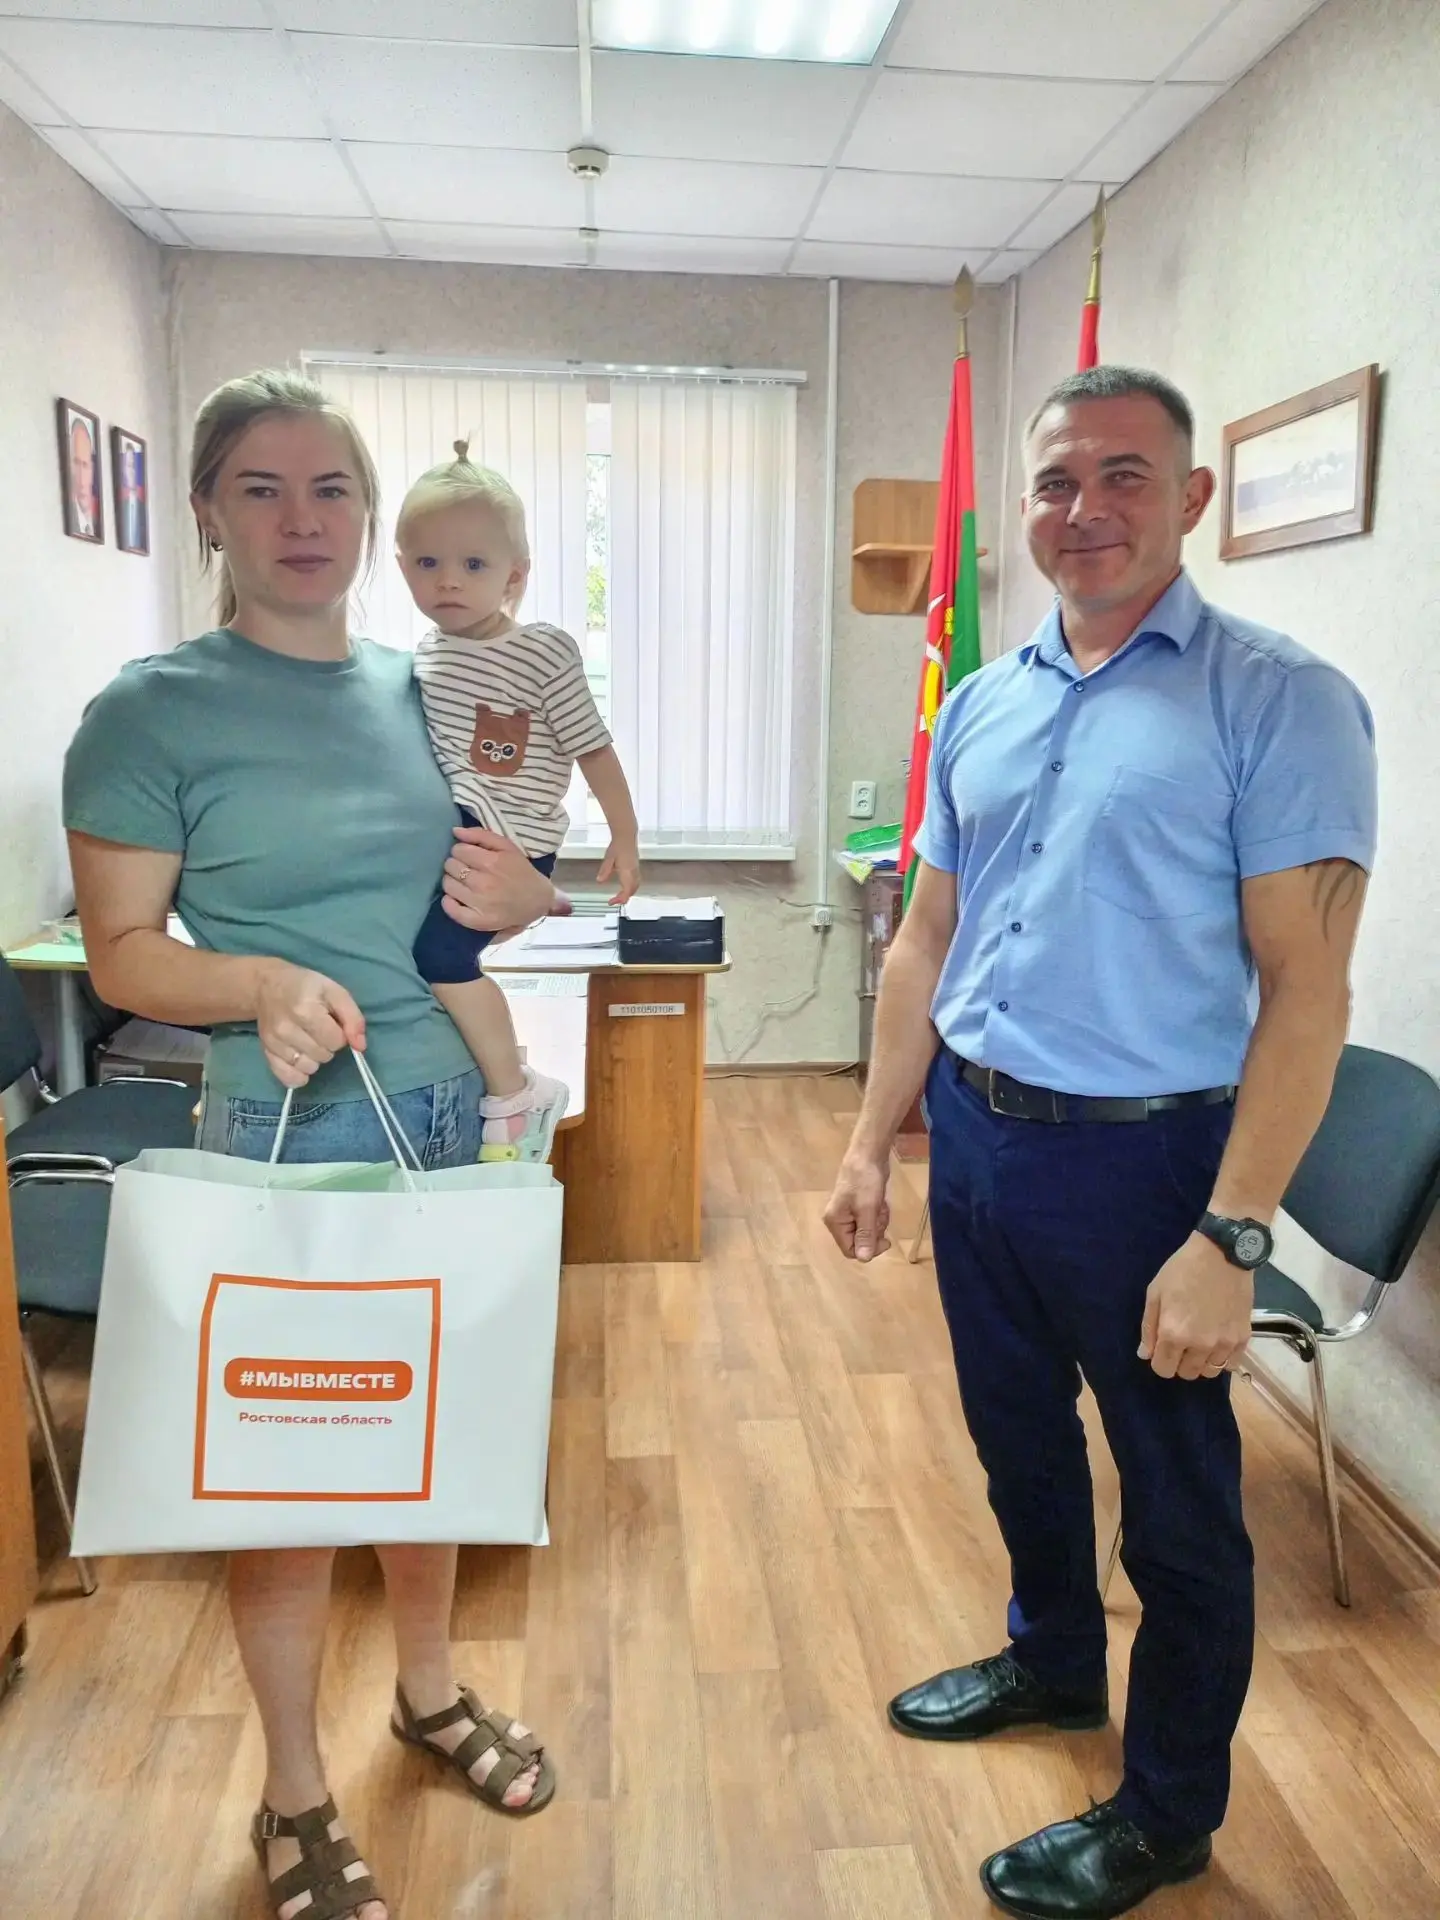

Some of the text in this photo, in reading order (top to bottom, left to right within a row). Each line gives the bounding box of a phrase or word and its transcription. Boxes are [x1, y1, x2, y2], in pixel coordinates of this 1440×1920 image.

[239, 1370, 396, 1389] #МЫВМЕСТЕ
[239, 1412, 393, 1426] Ростовская область
